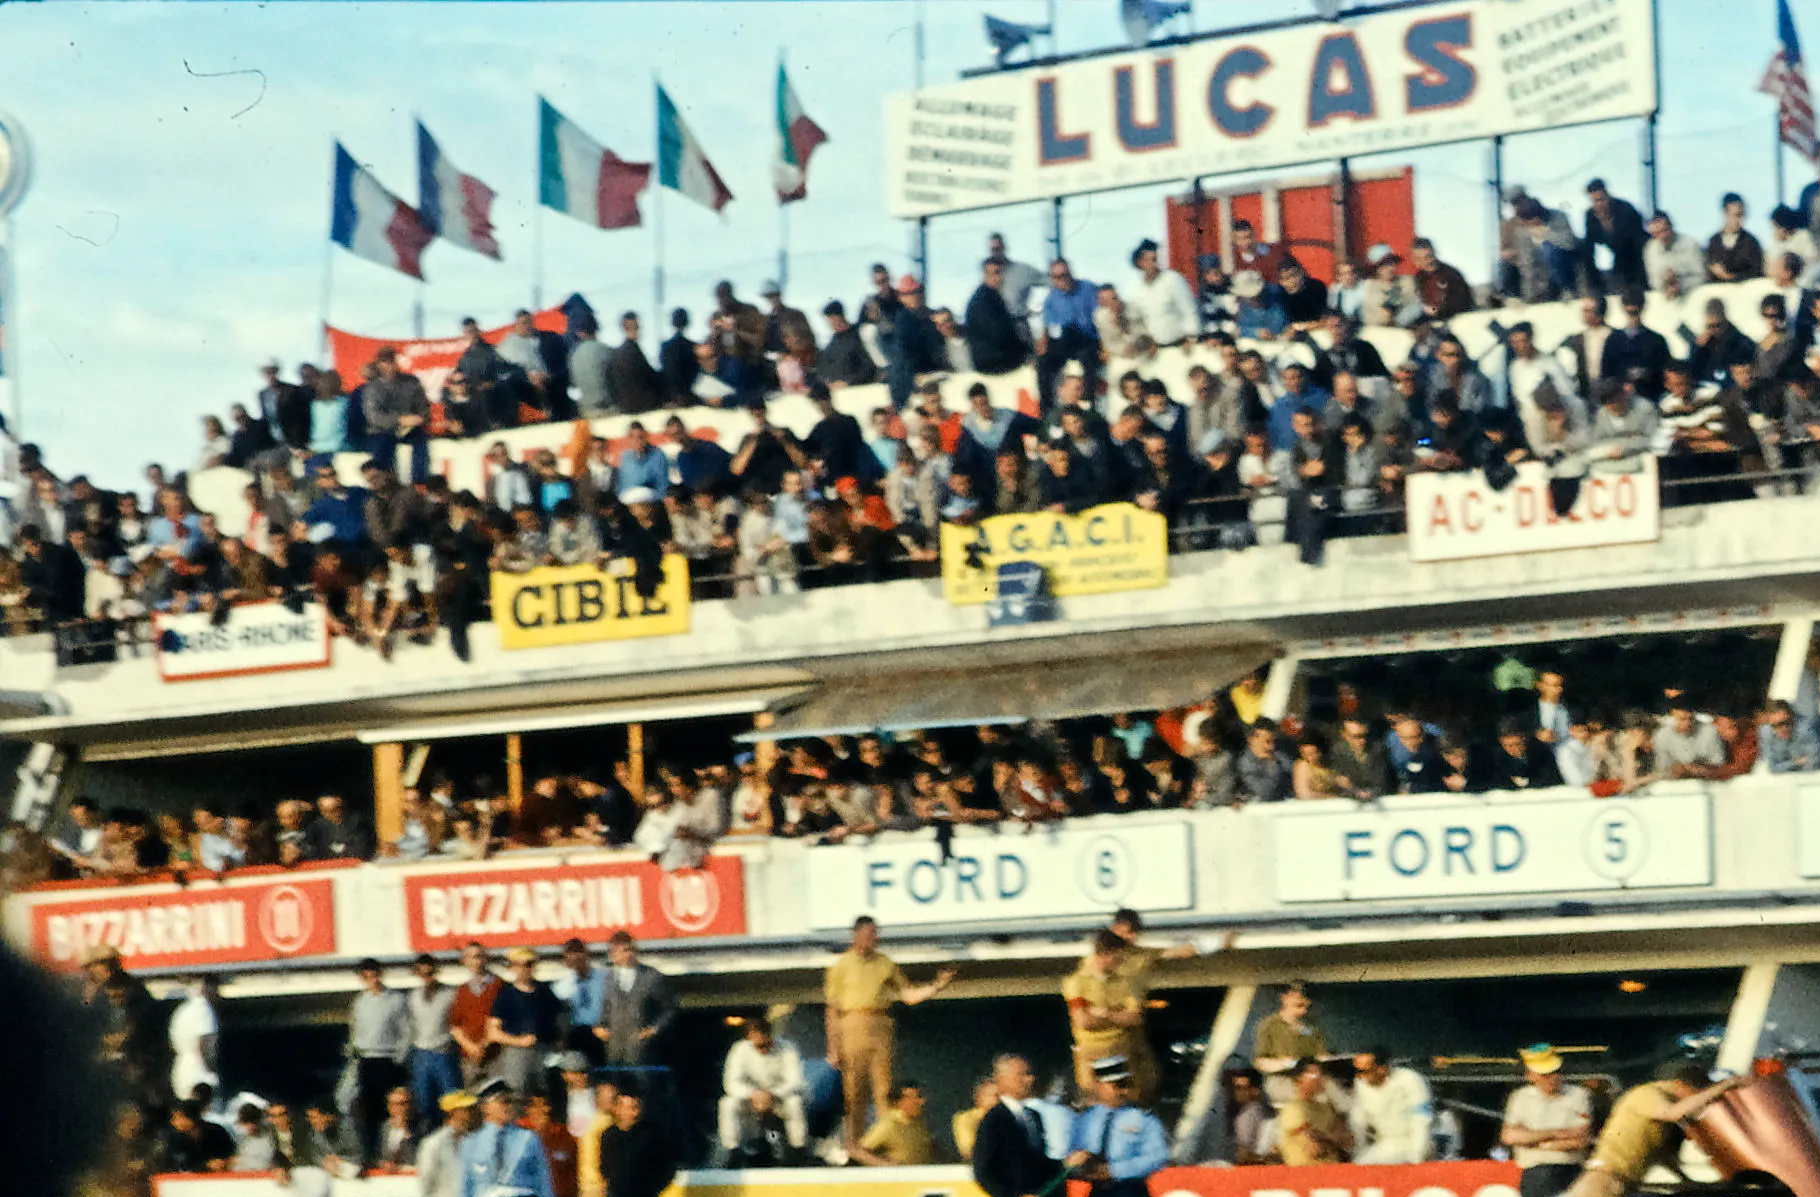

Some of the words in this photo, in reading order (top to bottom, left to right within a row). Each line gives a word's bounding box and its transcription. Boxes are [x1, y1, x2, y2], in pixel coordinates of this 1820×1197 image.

[1035, 12, 1480, 168] LUCAS
[867, 853, 1030, 907] FORD
[1342, 824, 1528, 881] FORD
[1604, 821, 1629, 864] 5
[47, 900, 246, 961] BIZZARRINI
[420, 876, 644, 938] BIZZARRINI
